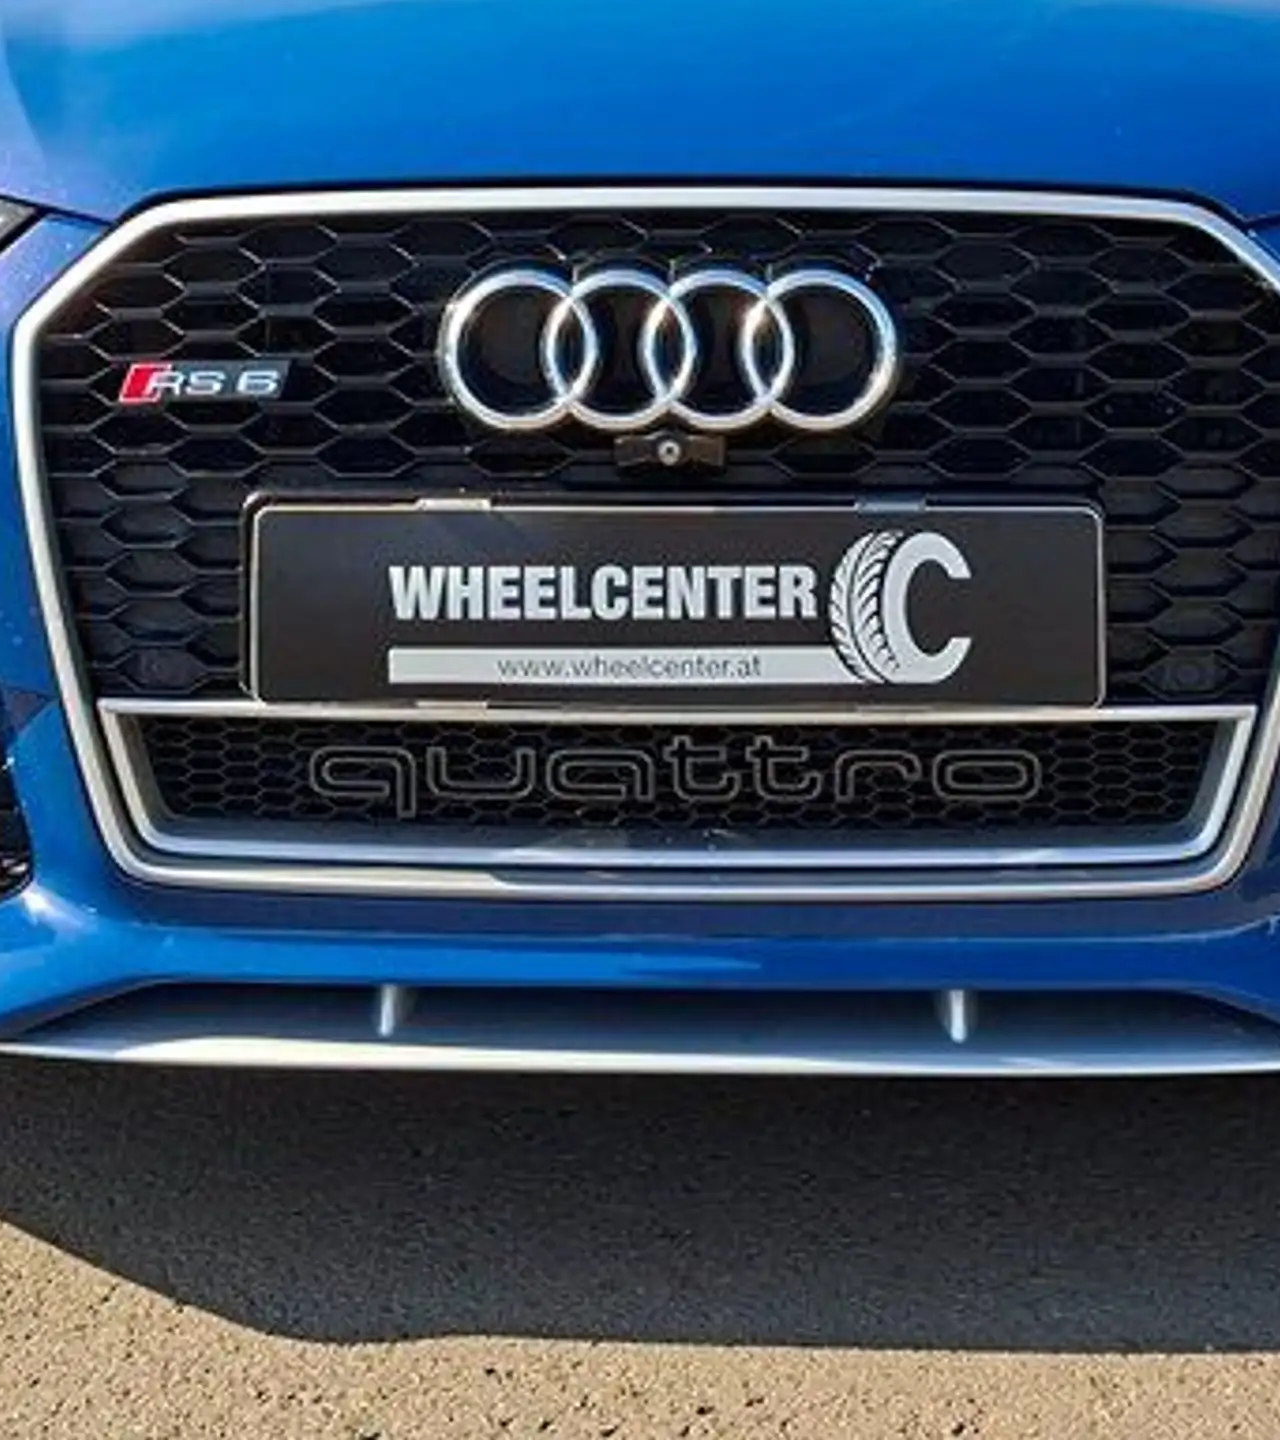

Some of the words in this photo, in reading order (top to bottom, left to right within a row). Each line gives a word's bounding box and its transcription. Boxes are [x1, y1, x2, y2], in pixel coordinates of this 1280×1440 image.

[388, 565, 818, 621] WHEELCENTER
[497, 654, 762, 678] www.wheelcenter.at
[310, 734, 1042, 819] quattro
